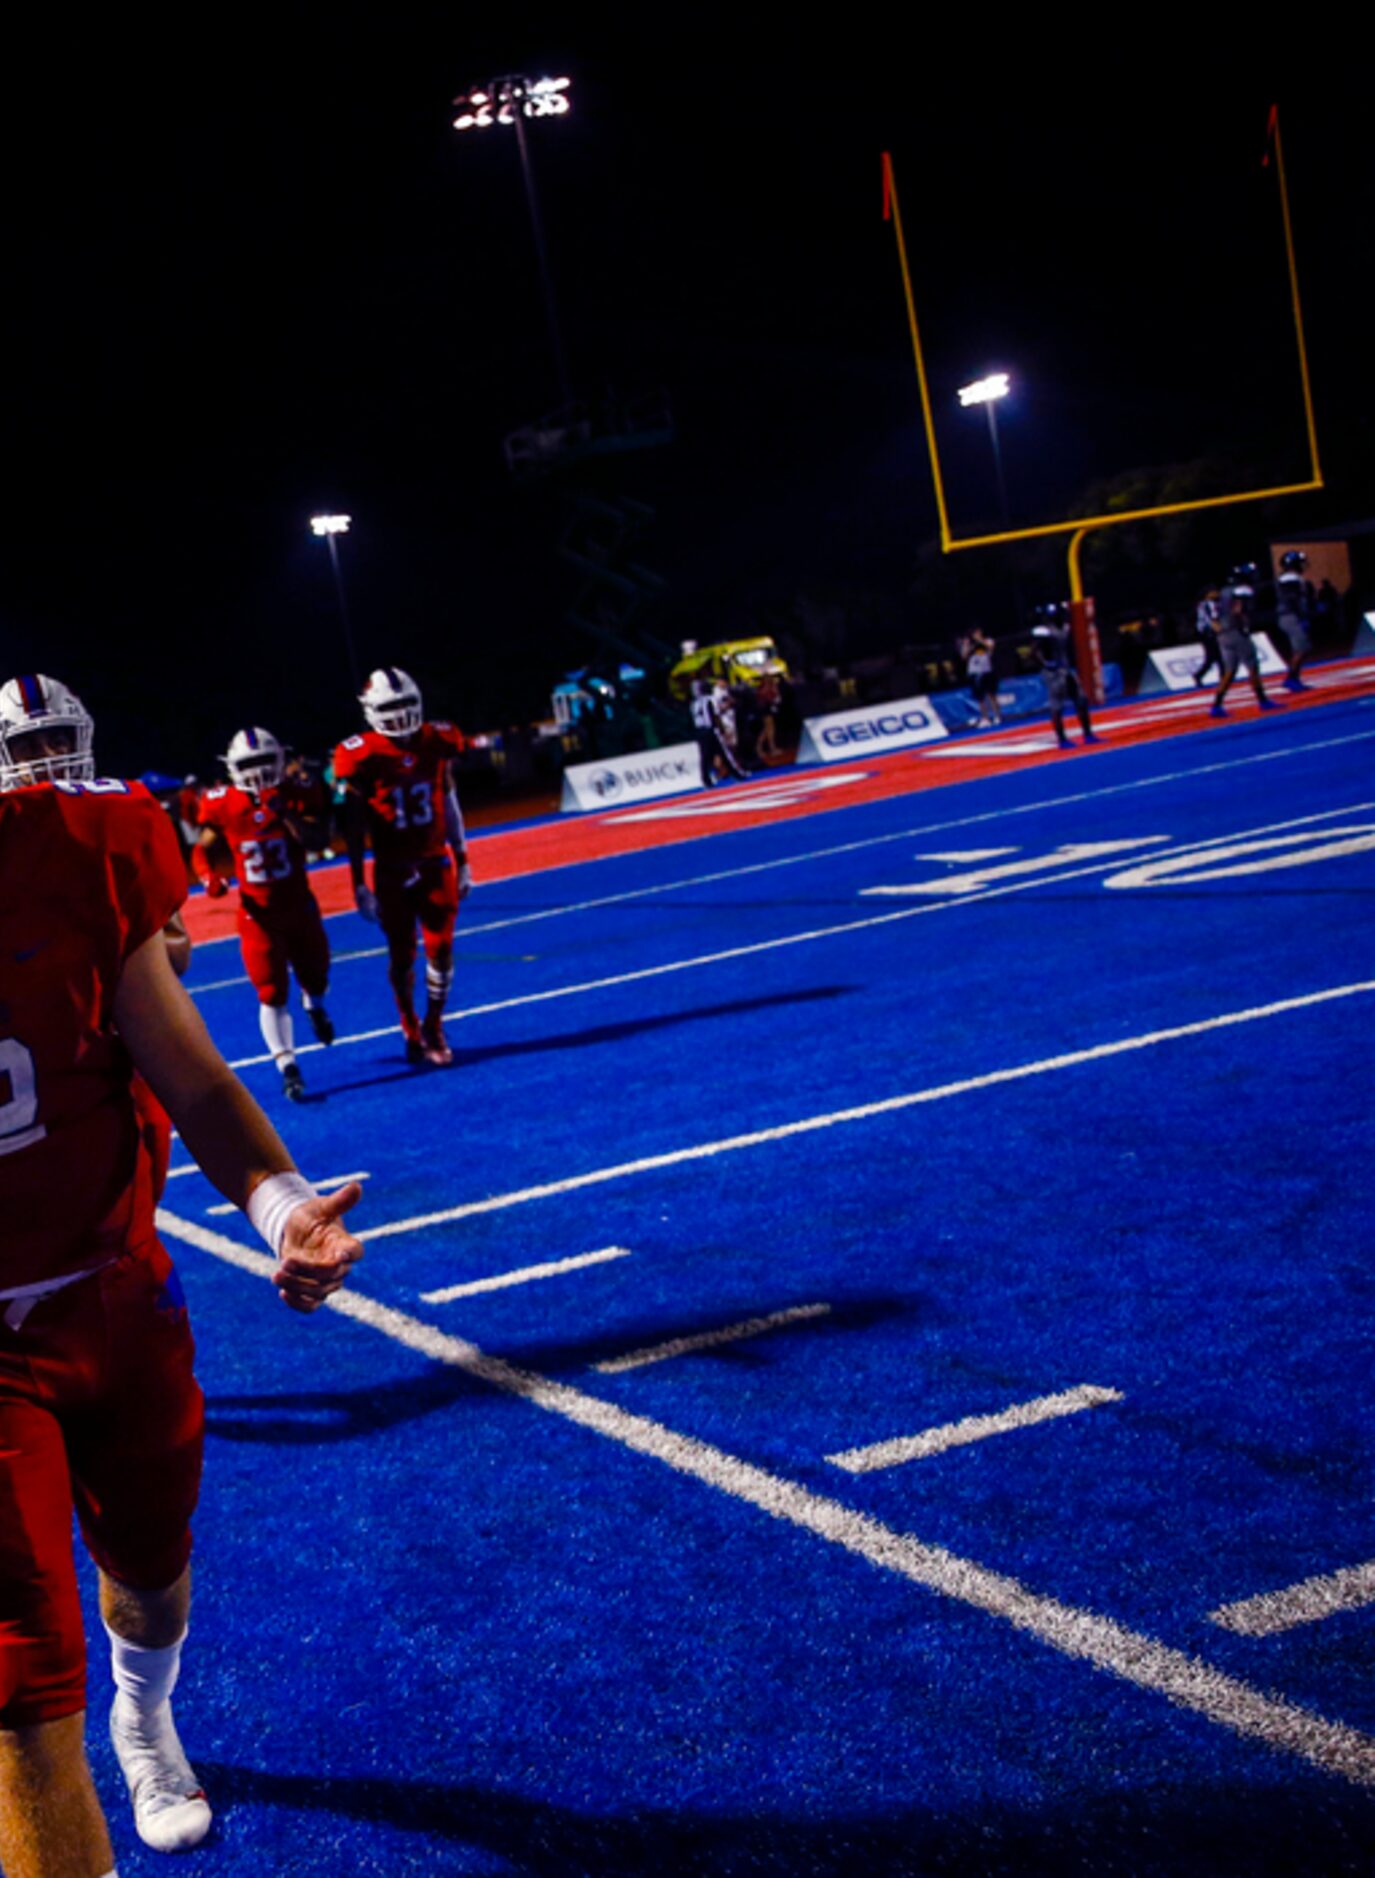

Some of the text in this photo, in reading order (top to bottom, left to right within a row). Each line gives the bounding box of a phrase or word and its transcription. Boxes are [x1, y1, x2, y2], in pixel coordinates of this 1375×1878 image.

[822, 711, 929, 746] GEICO
[623, 761, 690, 787] BUICK
[391, 781, 435, 830] 13
[239, 836, 294, 884] 23
